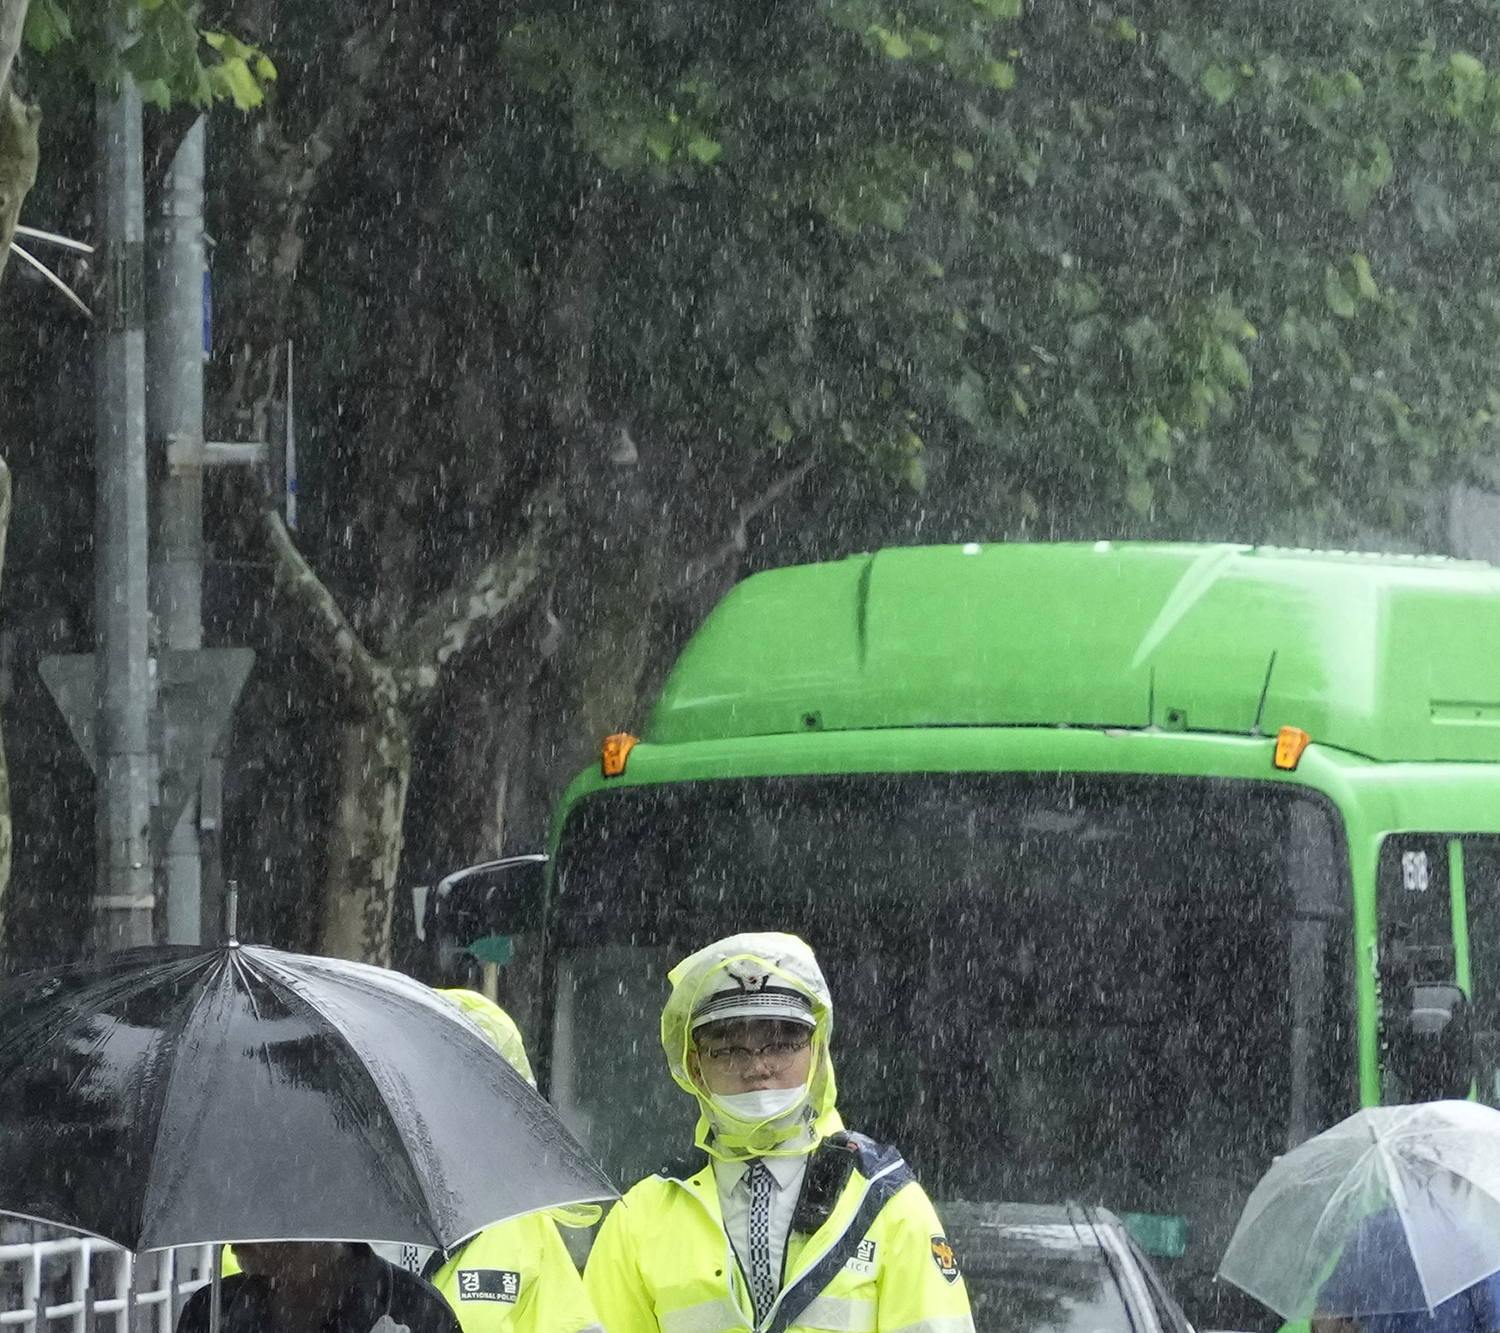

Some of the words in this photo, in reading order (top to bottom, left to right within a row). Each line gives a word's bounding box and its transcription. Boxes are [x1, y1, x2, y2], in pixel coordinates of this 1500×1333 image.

[856, 1239, 874, 1261] 찰
[846, 1262, 869, 1273] ICE
[461, 1291, 496, 1300] NATIONAL
[496, 1293, 517, 1303] POLIC
